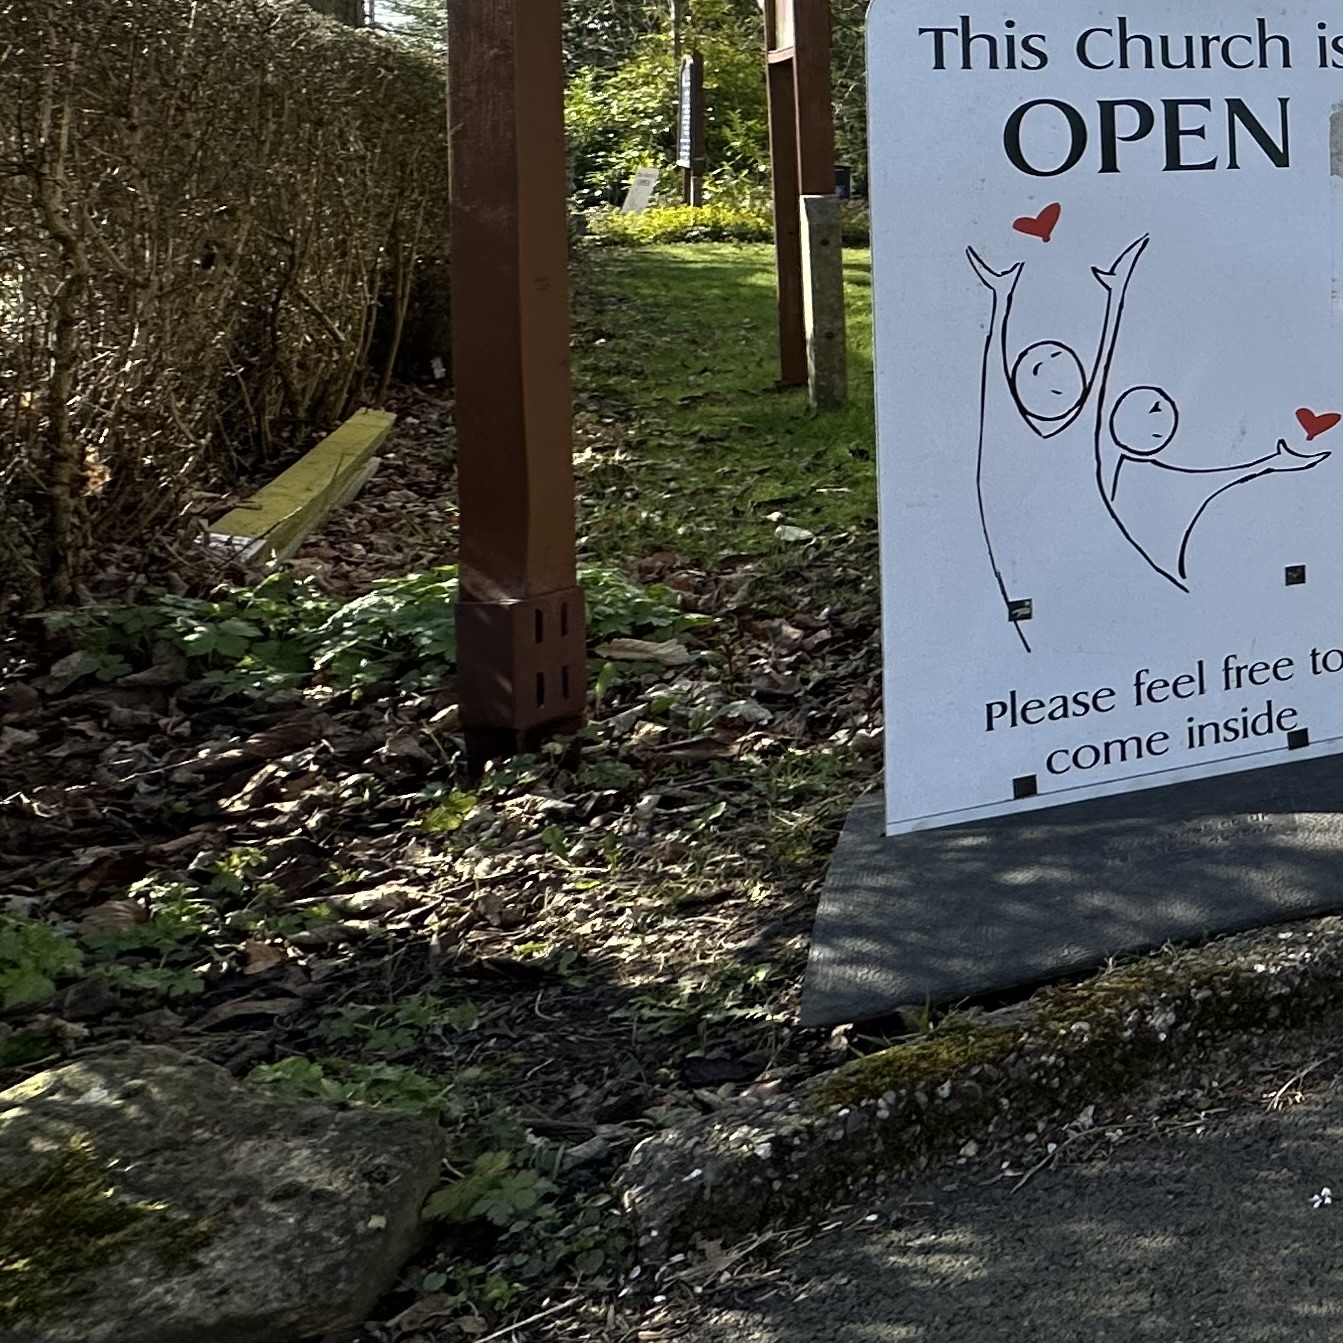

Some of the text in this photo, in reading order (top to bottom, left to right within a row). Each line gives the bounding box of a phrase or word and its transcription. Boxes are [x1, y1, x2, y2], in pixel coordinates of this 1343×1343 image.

[918, 14, 1049, 71] This
[1076, 15, 1293, 70] Church
[1002, 96, 1291, 178] OPEN
[984, 689, 1117, 733] Please
[1132, 659, 1206, 707] feel
[1221, 653, 1296, 692] free
[1045, 699, 1300, 776] come inside
